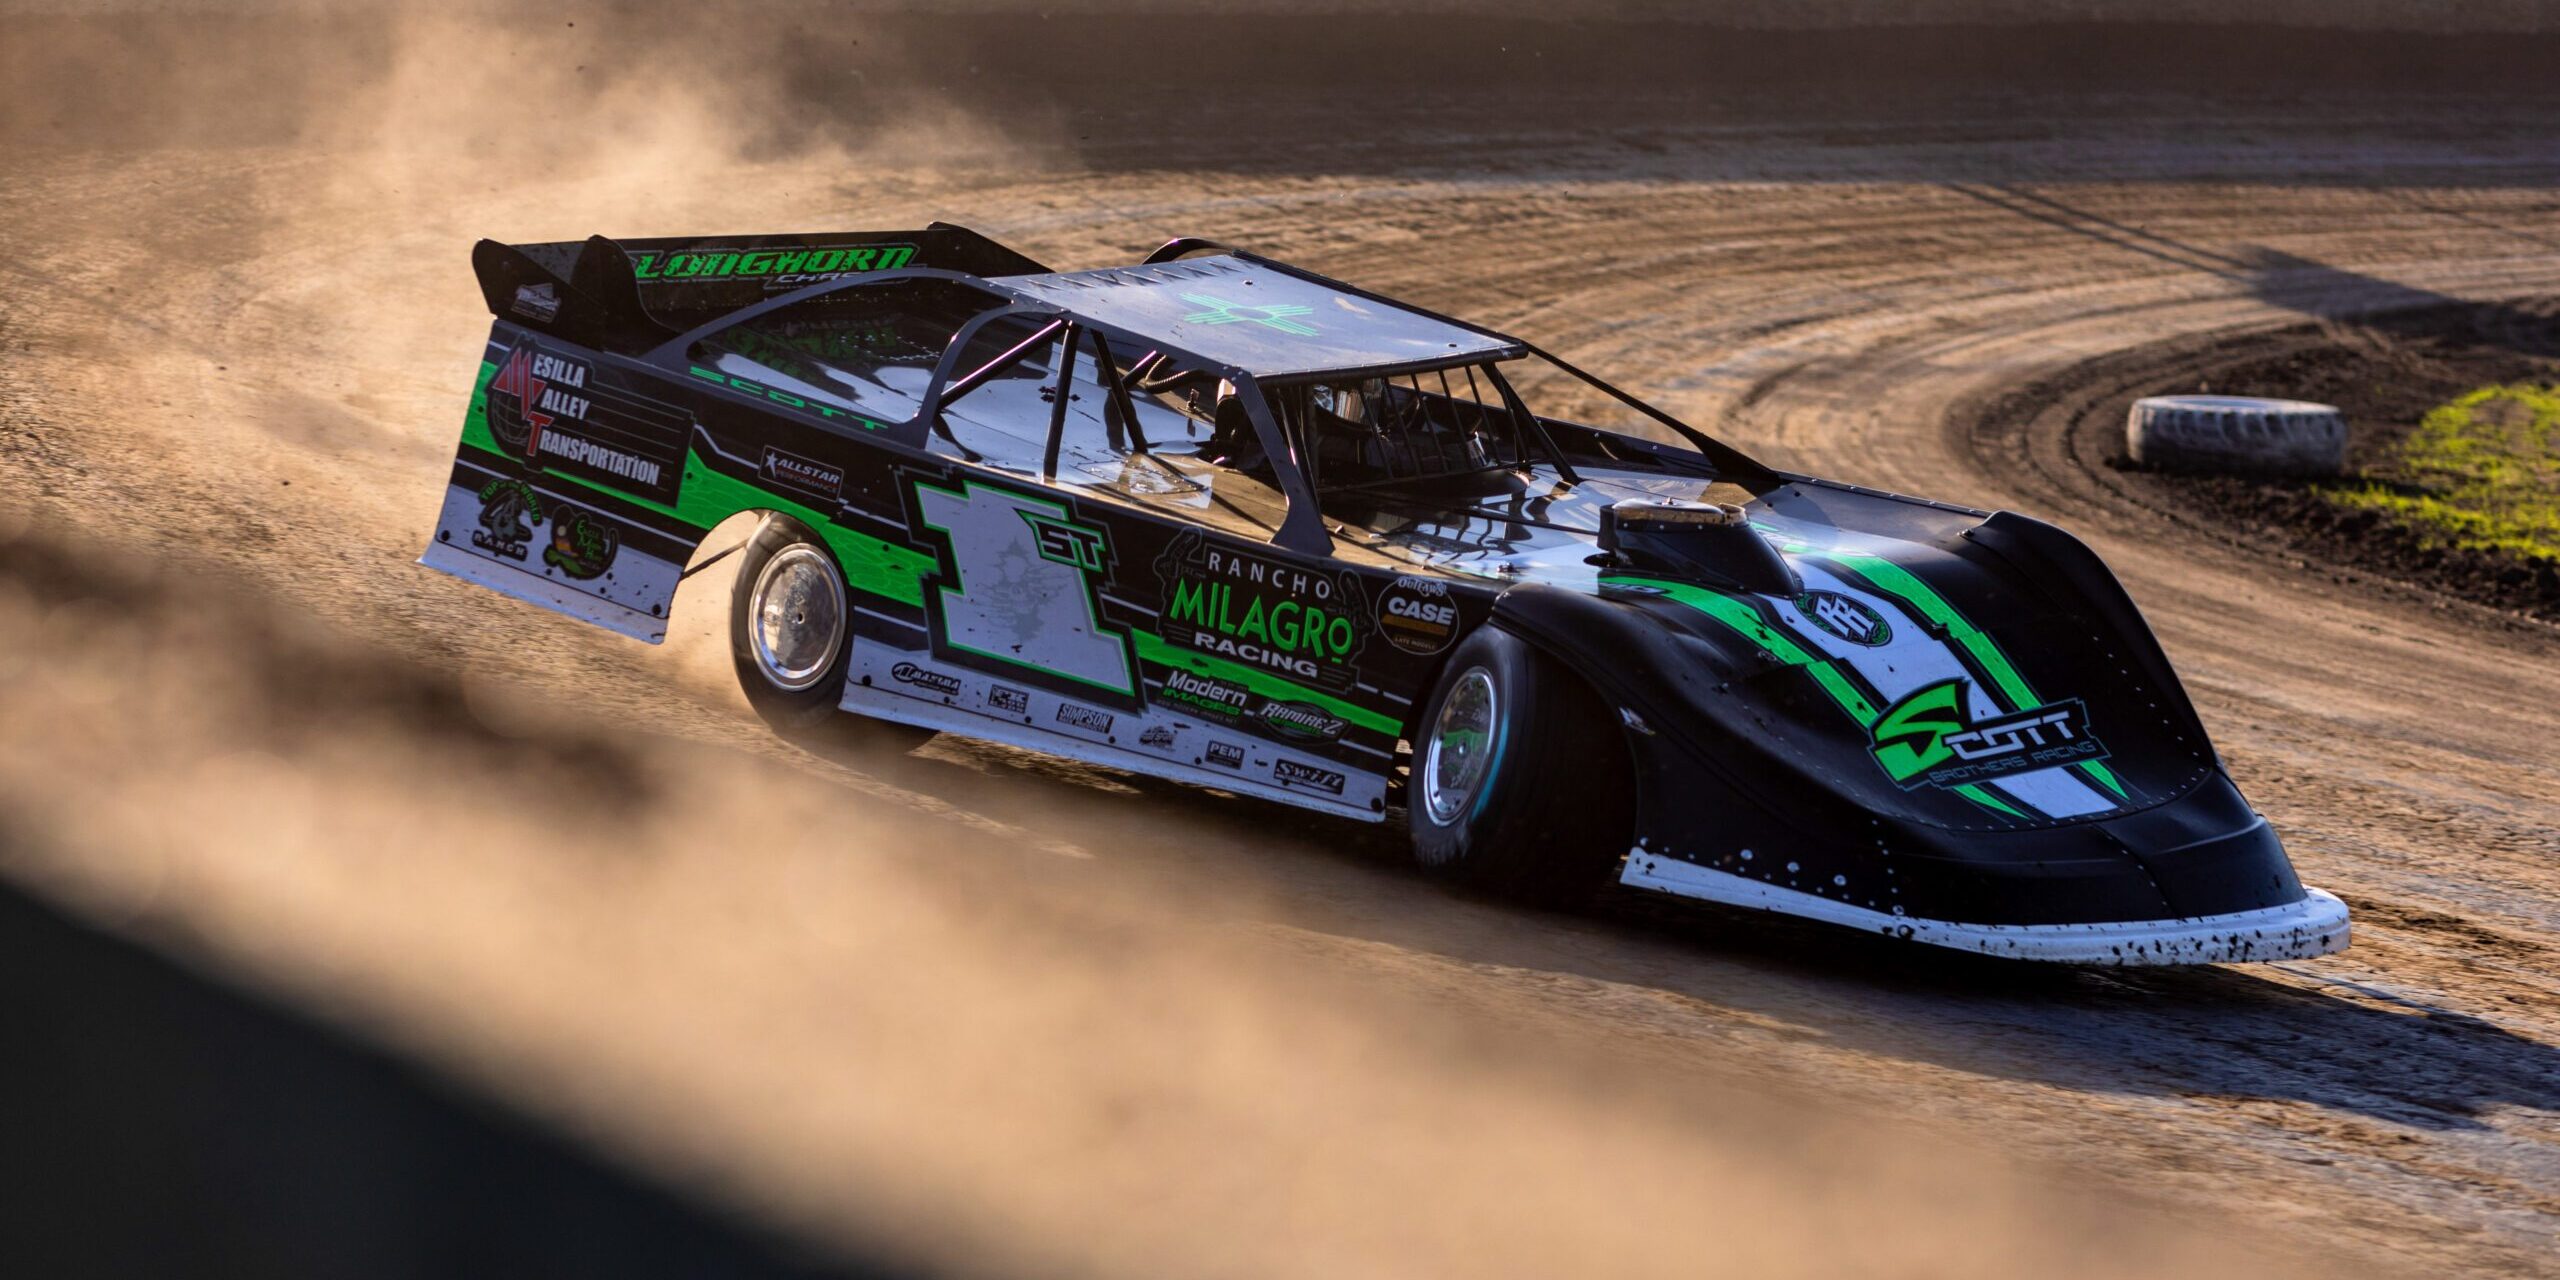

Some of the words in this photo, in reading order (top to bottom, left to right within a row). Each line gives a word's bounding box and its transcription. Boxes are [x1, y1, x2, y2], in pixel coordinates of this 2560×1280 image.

[635, 246, 915, 279] LONGHORN
[493, 347, 586, 396] MESILLA
[520, 376, 590, 421] VALLEY
[689, 366, 889, 430] SCOTT
[526, 411, 660, 486] TRANSPORTATION
[777, 457, 841, 485] ALLSTAR
[480, 481, 499, 501] TOP
[473, 532, 526, 556] RANCH
[1208, 551, 1331, 600] RANCHO
[1169, 576, 1353, 661] MILAGRO
[1388, 596, 1456, 626] CASE
[1194, 631, 1318, 679] RACING
[1162, 688, 1242, 717] IMAGES
[1166, 670, 1247, 707] Modern
[1060, 704, 1111, 728] SIMPSON
[1260, 702, 1344, 735] RAMIREZ
[1874, 682, 2075, 782] SCOTT
[1209, 742, 1243, 760] PEM
[1928, 755, 2028, 783] BROTHERS
[2031, 740, 2098, 764] RACING
[1278, 760, 1343, 788] Swift
